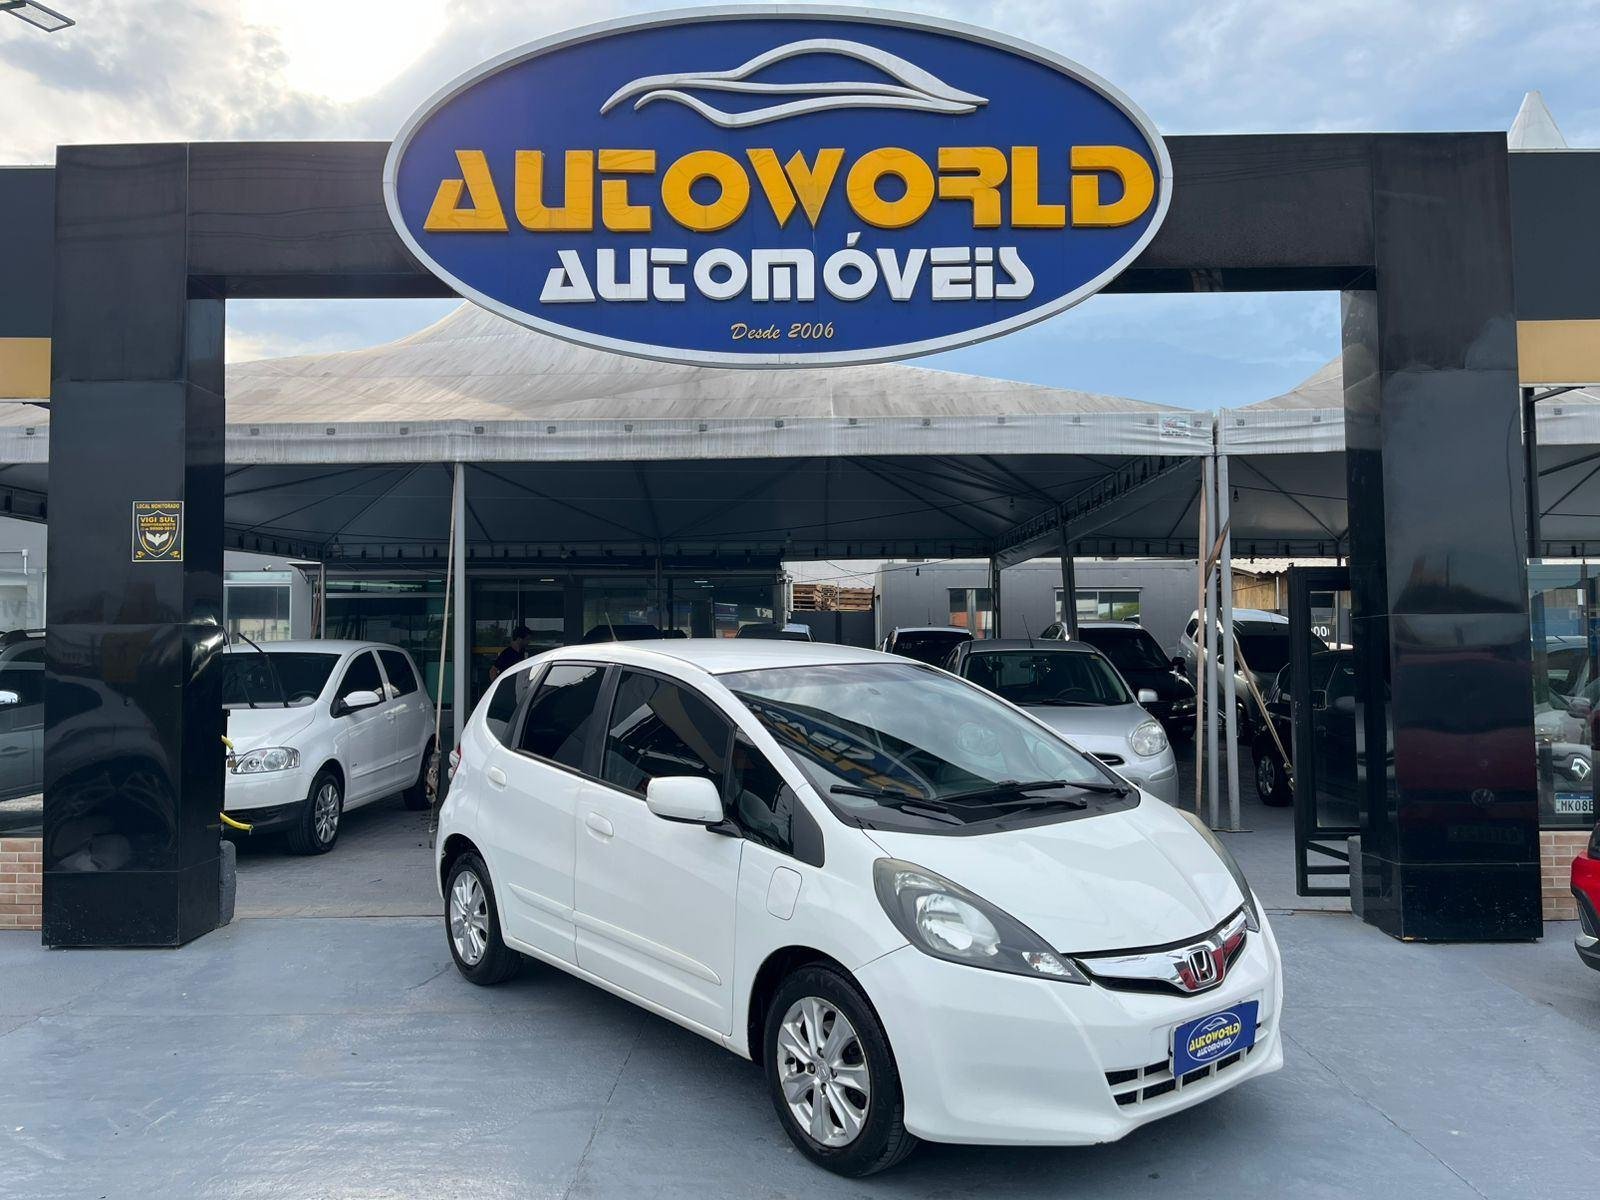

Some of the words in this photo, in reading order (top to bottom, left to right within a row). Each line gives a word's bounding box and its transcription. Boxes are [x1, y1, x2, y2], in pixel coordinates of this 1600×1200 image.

[424, 145, 1155, 233] AUTOWORLD
[539, 231, 1035, 303] AUTOMÓVEIS
[730, 323, 781, 340] Desde
[787, 321, 834, 339] 2006
[1189, 1022, 1241, 1052] AUTOWORLD
